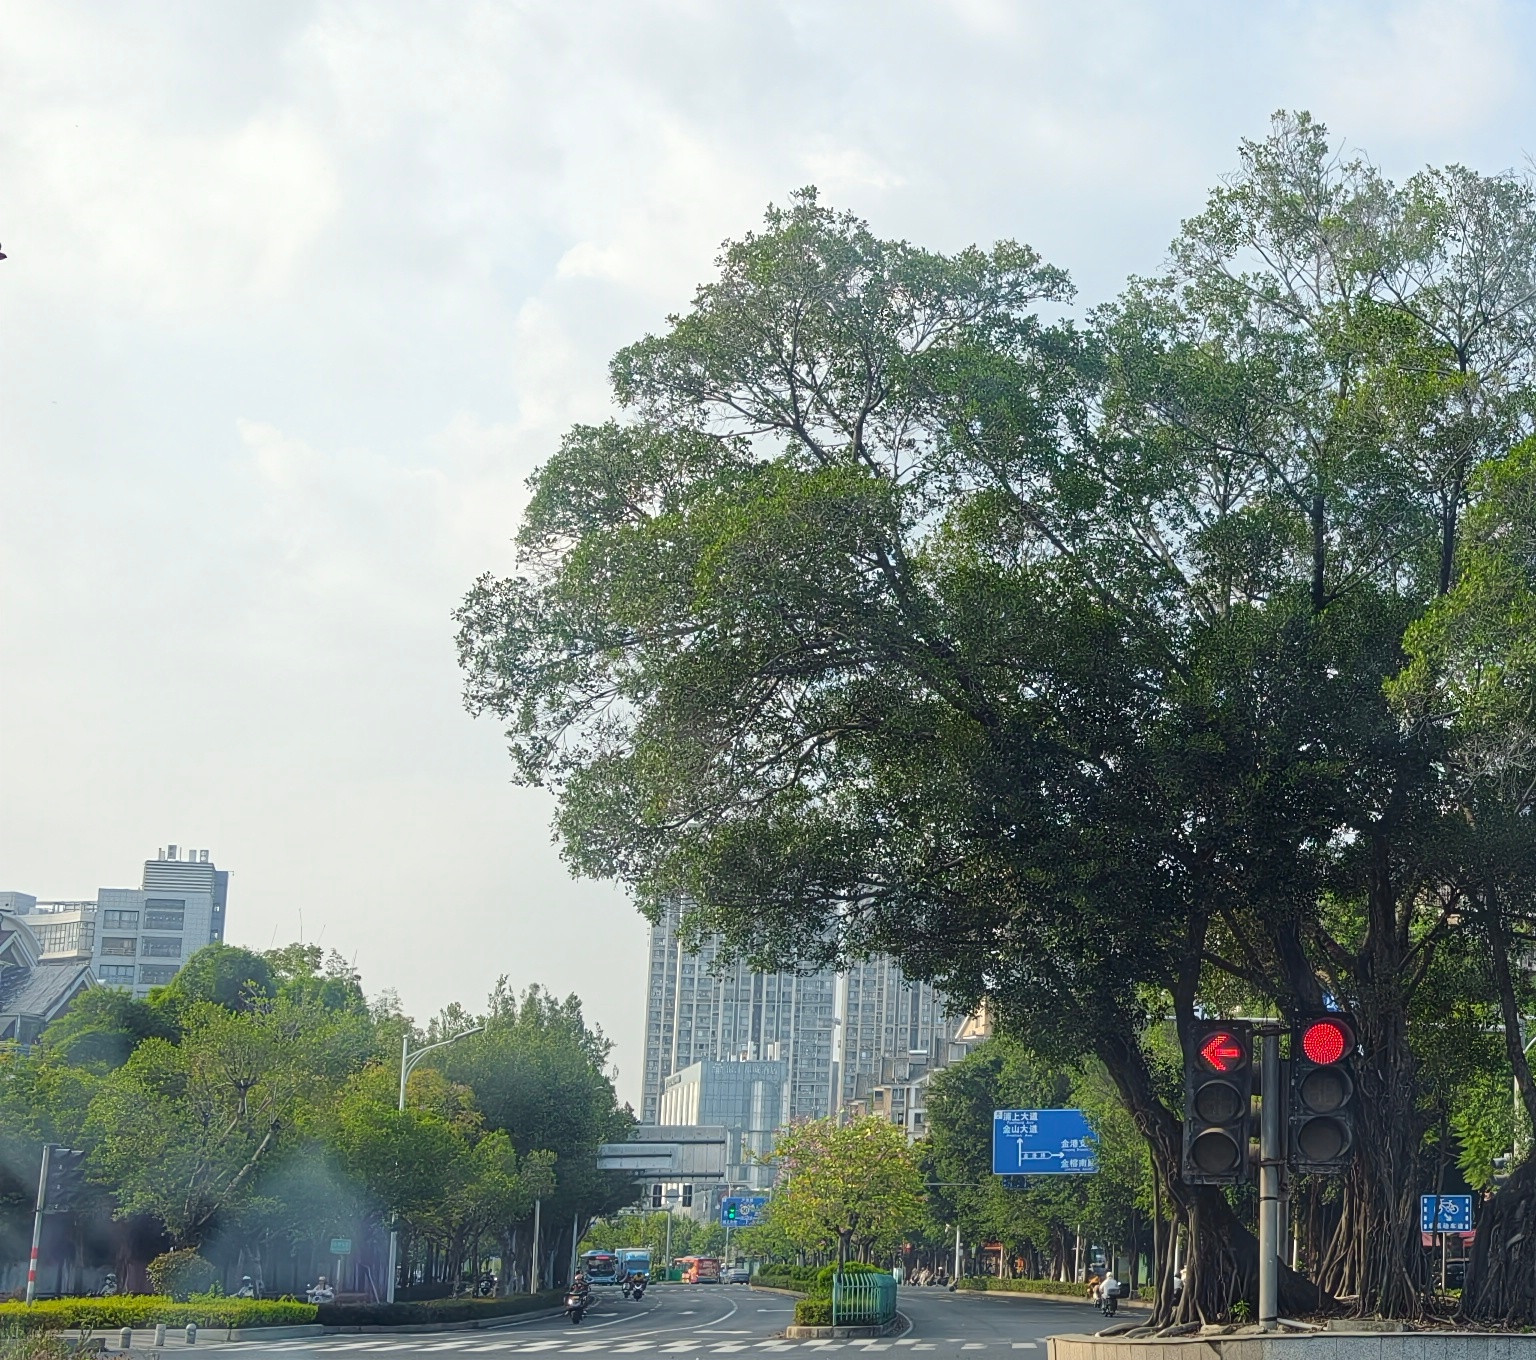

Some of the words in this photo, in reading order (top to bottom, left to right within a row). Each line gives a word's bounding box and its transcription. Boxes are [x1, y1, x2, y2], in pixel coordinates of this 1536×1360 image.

[1003, 1112, 1038, 1121] 浦上大道
[1002, 1124, 1038, 1134] 金山大道
[1061, 1139, 1093, 1149] 金港支
